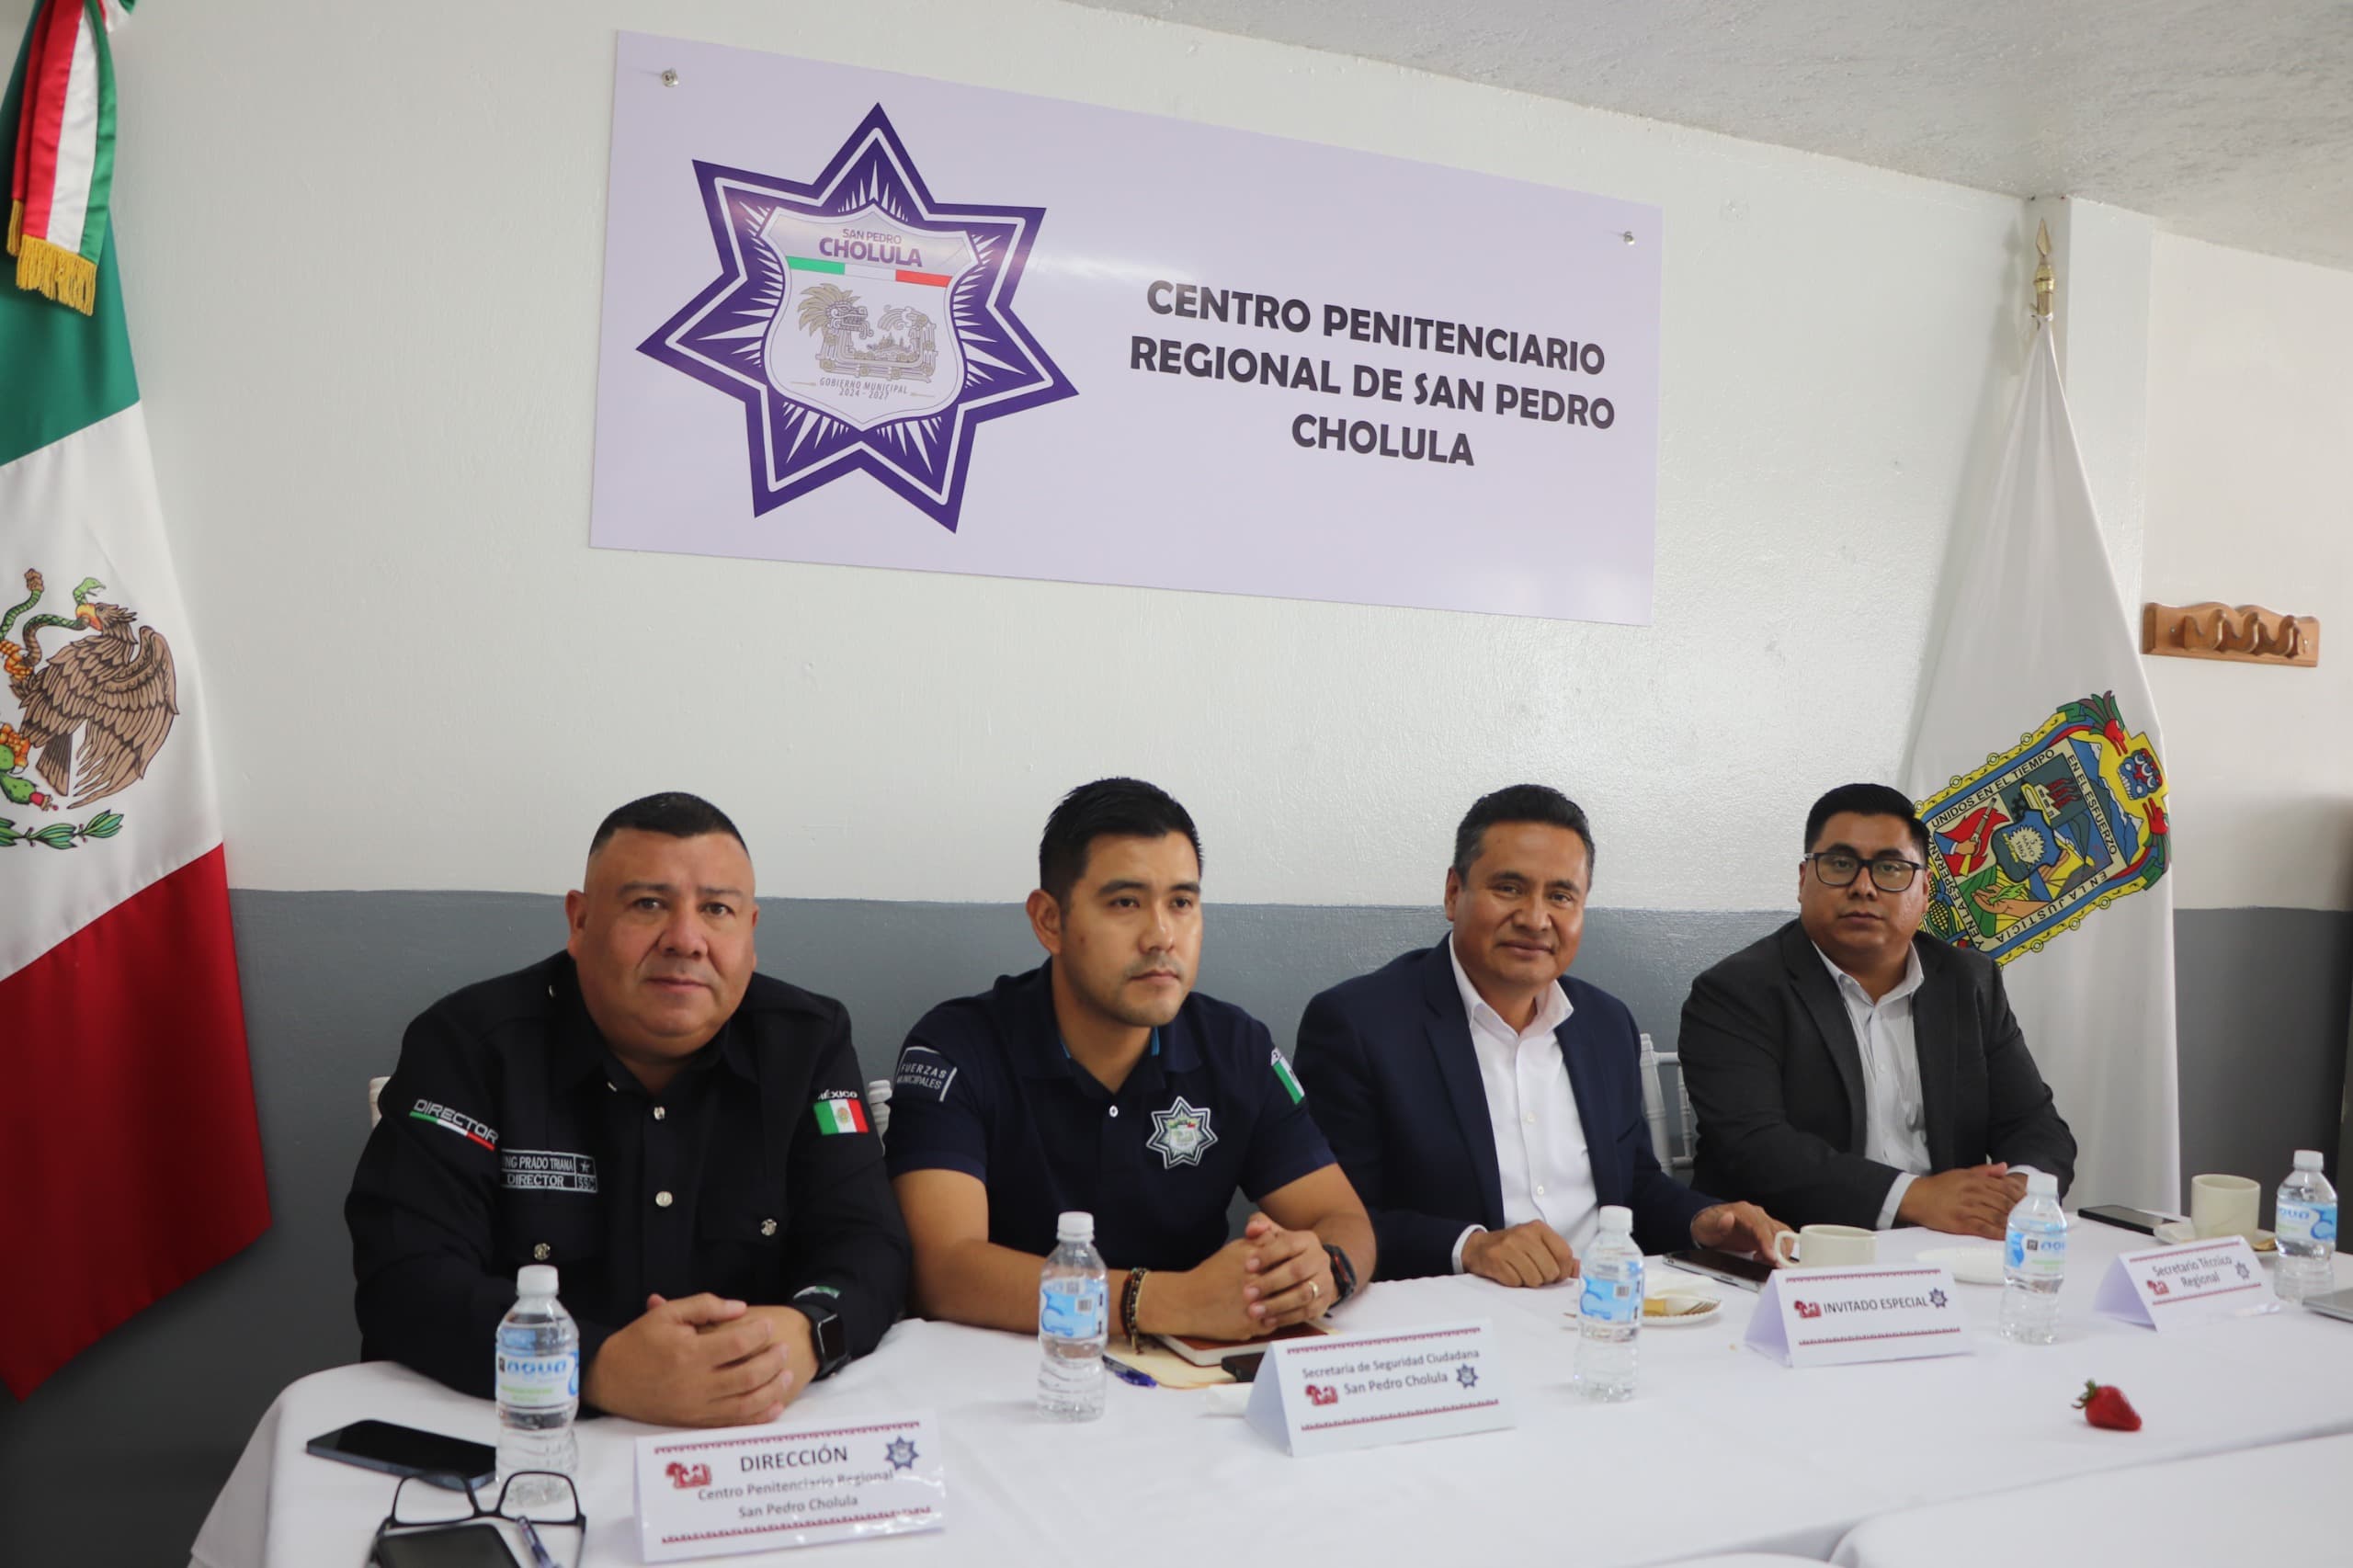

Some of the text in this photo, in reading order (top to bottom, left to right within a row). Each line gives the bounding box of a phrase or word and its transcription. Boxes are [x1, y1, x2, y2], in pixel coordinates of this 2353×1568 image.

[843, 228, 902, 244] SAN PEDRO
[819, 237, 923, 267] CHOLULA
[1147, 279, 1606, 375] CENTRO PENITENCIARIO
[819, 377, 908, 394] GOBIERNO MUNICIPAL
[839, 388, 860, 397] 2024
[869, 391, 890, 400] 2027
[1130, 335, 1615, 429] REGIONAL DE SAN PEDRO
[1291, 414, 1474, 466] CHOLULA
[1931, 749, 2055, 828] UNIDOS EN EL TIEMPO
[2067, 755, 2118, 855] EN EL ESFUERZO
[1928, 835, 1984, 949] Y EN LA ESPERANZ
[1995, 871, 2108, 943] EN LA JUSTICIA
[901, 1062, 947, 1079] FUERZAS
[414, 1098, 499, 1144] DIRECTOR
[518, 1155, 549, 1170] PRADO
[550, 1157, 574, 1172] TRIANA
[506, 1173, 564, 1187] DIRECTOR
[2152, 1262, 2199, 1278] Secretario
[2180, 1272, 2220, 1290] Regional
[1824, 1296, 1928, 1314] INVITADO ESPECIAL
[1358, 1360, 1370, 1372] de
[1372, 1356, 1424, 1373] Seguridad
[1427, 1349, 1480, 1364] Ciudadana
[1344, 1370, 1449, 1395] San Pedro Cholula
[740, 1444, 848, 1472] DIRECCIÓN
[698, 1470, 893, 1502] Centro Penitenciario Regional
[739, 1494, 858, 1518] San Pedro Cholula
